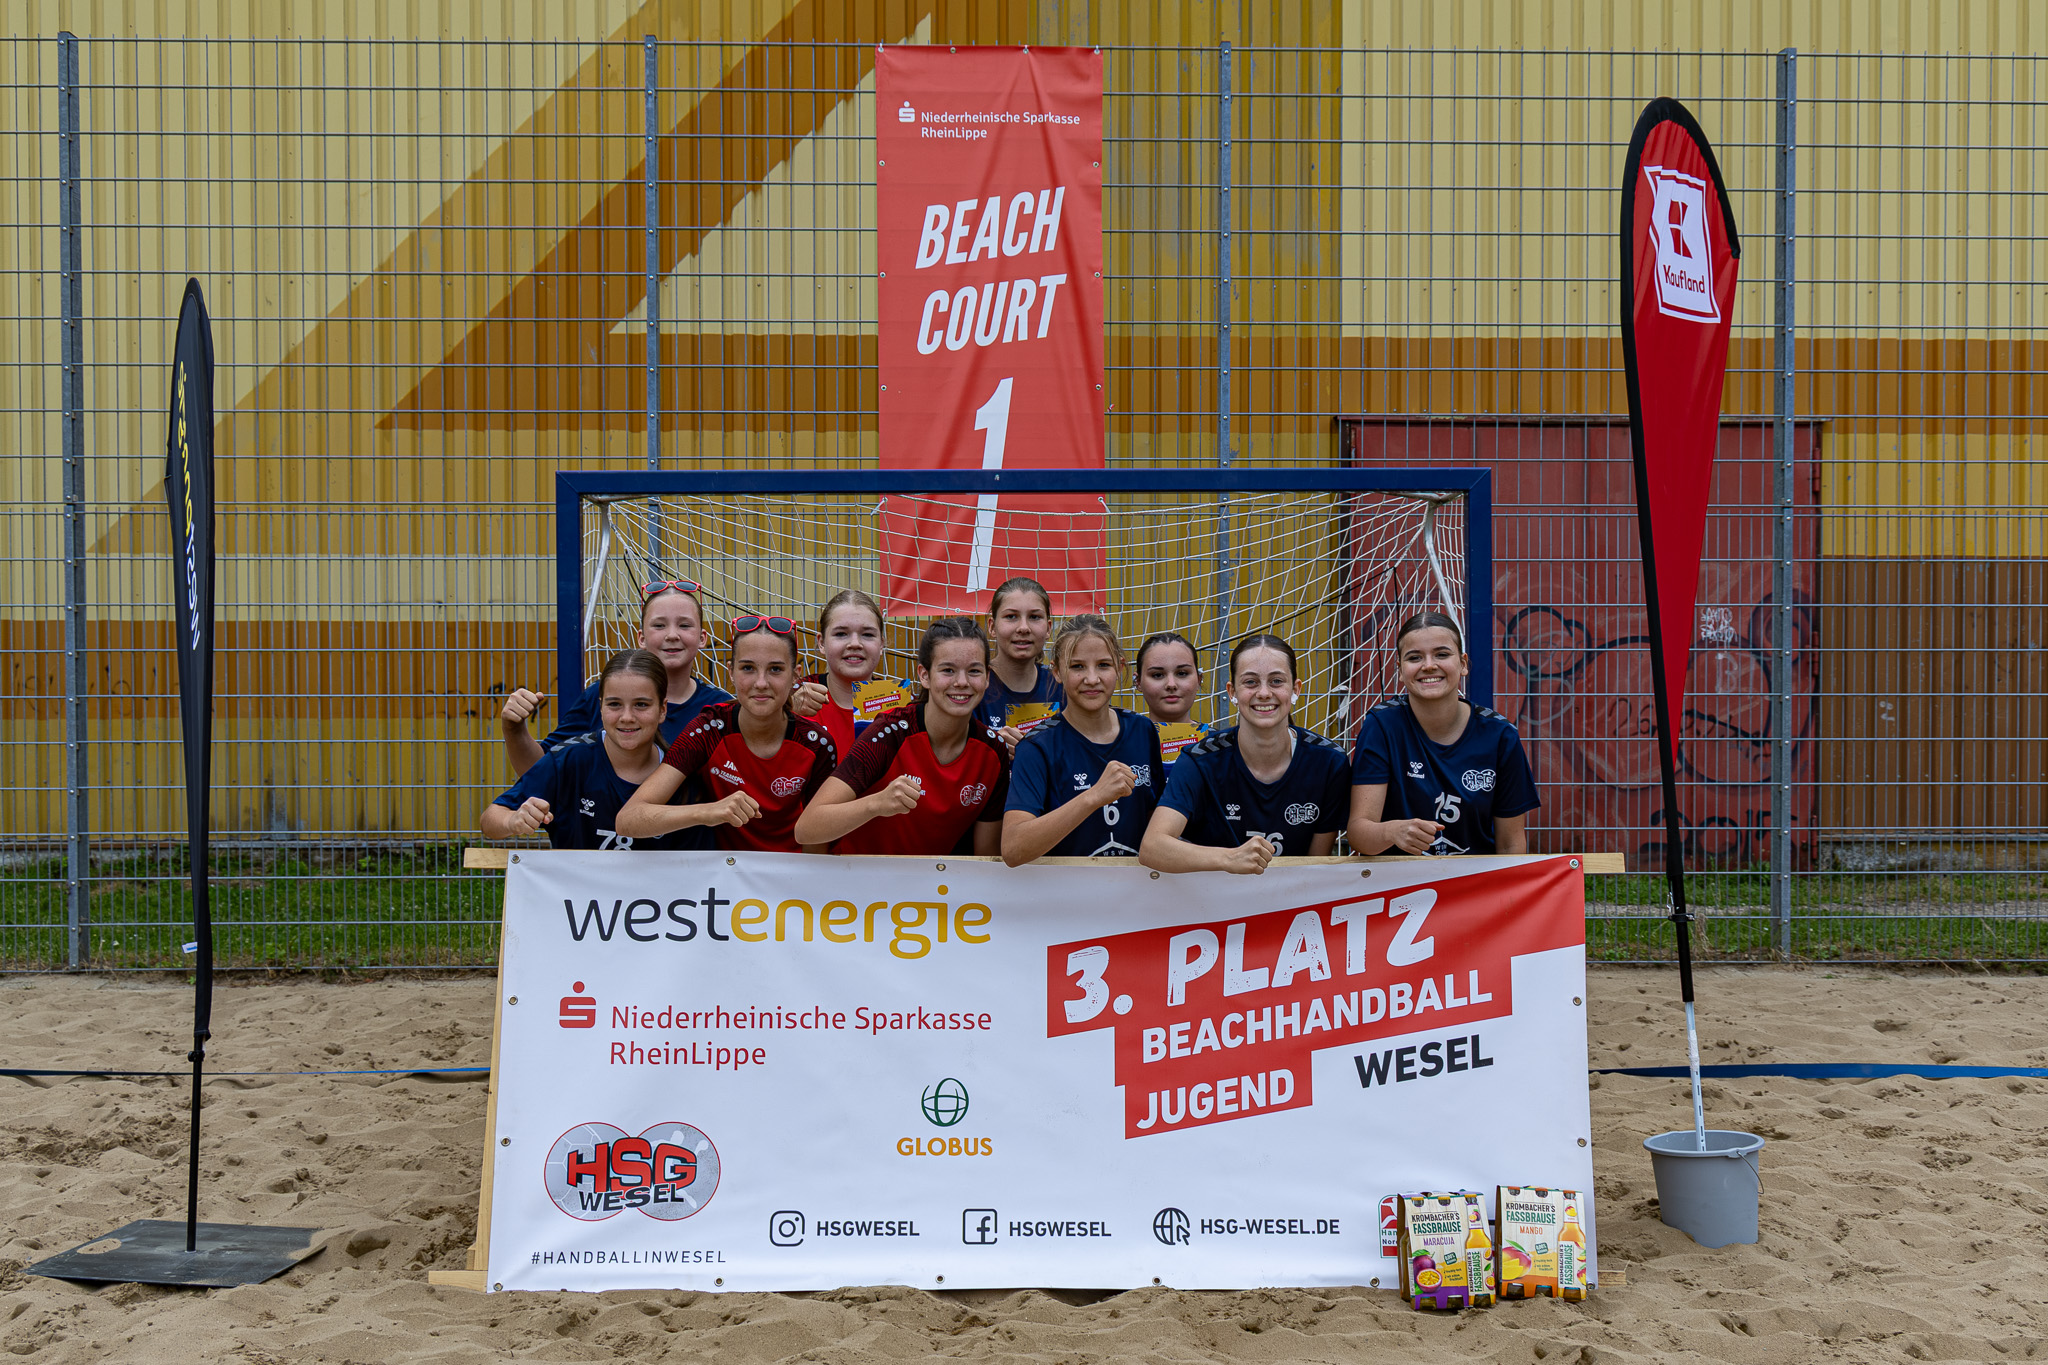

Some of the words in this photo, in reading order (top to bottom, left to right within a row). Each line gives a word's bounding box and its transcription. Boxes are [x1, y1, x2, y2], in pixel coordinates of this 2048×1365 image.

[921, 111, 1020, 124] Niederrheinische
[1023, 112, 1080, 126] Sparkasse
[921, 127, 988, 140] RheinLippe
[915, 186, 1065, 269] BEACH
[1663, 264, 1706, 293] Kaufland
[916, 274, 1067, 355] COURT
[966, 377, 1014, 593] 1
[1103, 799, 1120, 826] 6
[1434, 791, 1462, 823] 15
[596, 829, 633, 851] 78
[564, 884, 992, 960] westenergie
[1063, 946, 1133, 1023] 3.
[1167, 888, 1438, 1007] PLATZ
[612, 1005, 845, 1030] Niederrheinische
[855, 1006, 992, 1036] Sparkasse
[1142, 969, 1492, 1063] BEACHHANDBALL
[610, 1041, 766, 1071] RheinLippe
[1354, 1034, 1494, 1088] WESEL
[1136, 1068, 1294, 1129] JUGEND
[897, 1137, 993, 1157] GLOBUS
[567, 1136, 697, 1199] HSG
[579, 1183, 684, 1212] WESEL
[1506, 1202, 1556, 1212] KROMBACHER'S
[816, 1220, 920, 1237] HSGWESEL
[1009, 1221, 1112, 1237] HSGWESEL
[1200, 1218, 1340, 1235] HSG-WESEL.DE
[1411, 1213, 1460, 1222] KROMBACHER'S
[1412, 1221, 1462, 1235] FASSBRAUSE
[1506, 1211, 1556, 1224] FASSBRAUSE
[1519, 1225, 1543, 1235] MANGO
[1423, 1237, 1455, 1246] MARACUJA
[531, 1250, 726, 1264] #HANDBALLINWESEL
[1472, 1251, 1483, 1292] FASSBRAUSE
[1564, 1243, 1573, 1285] FASSBRAUSE
